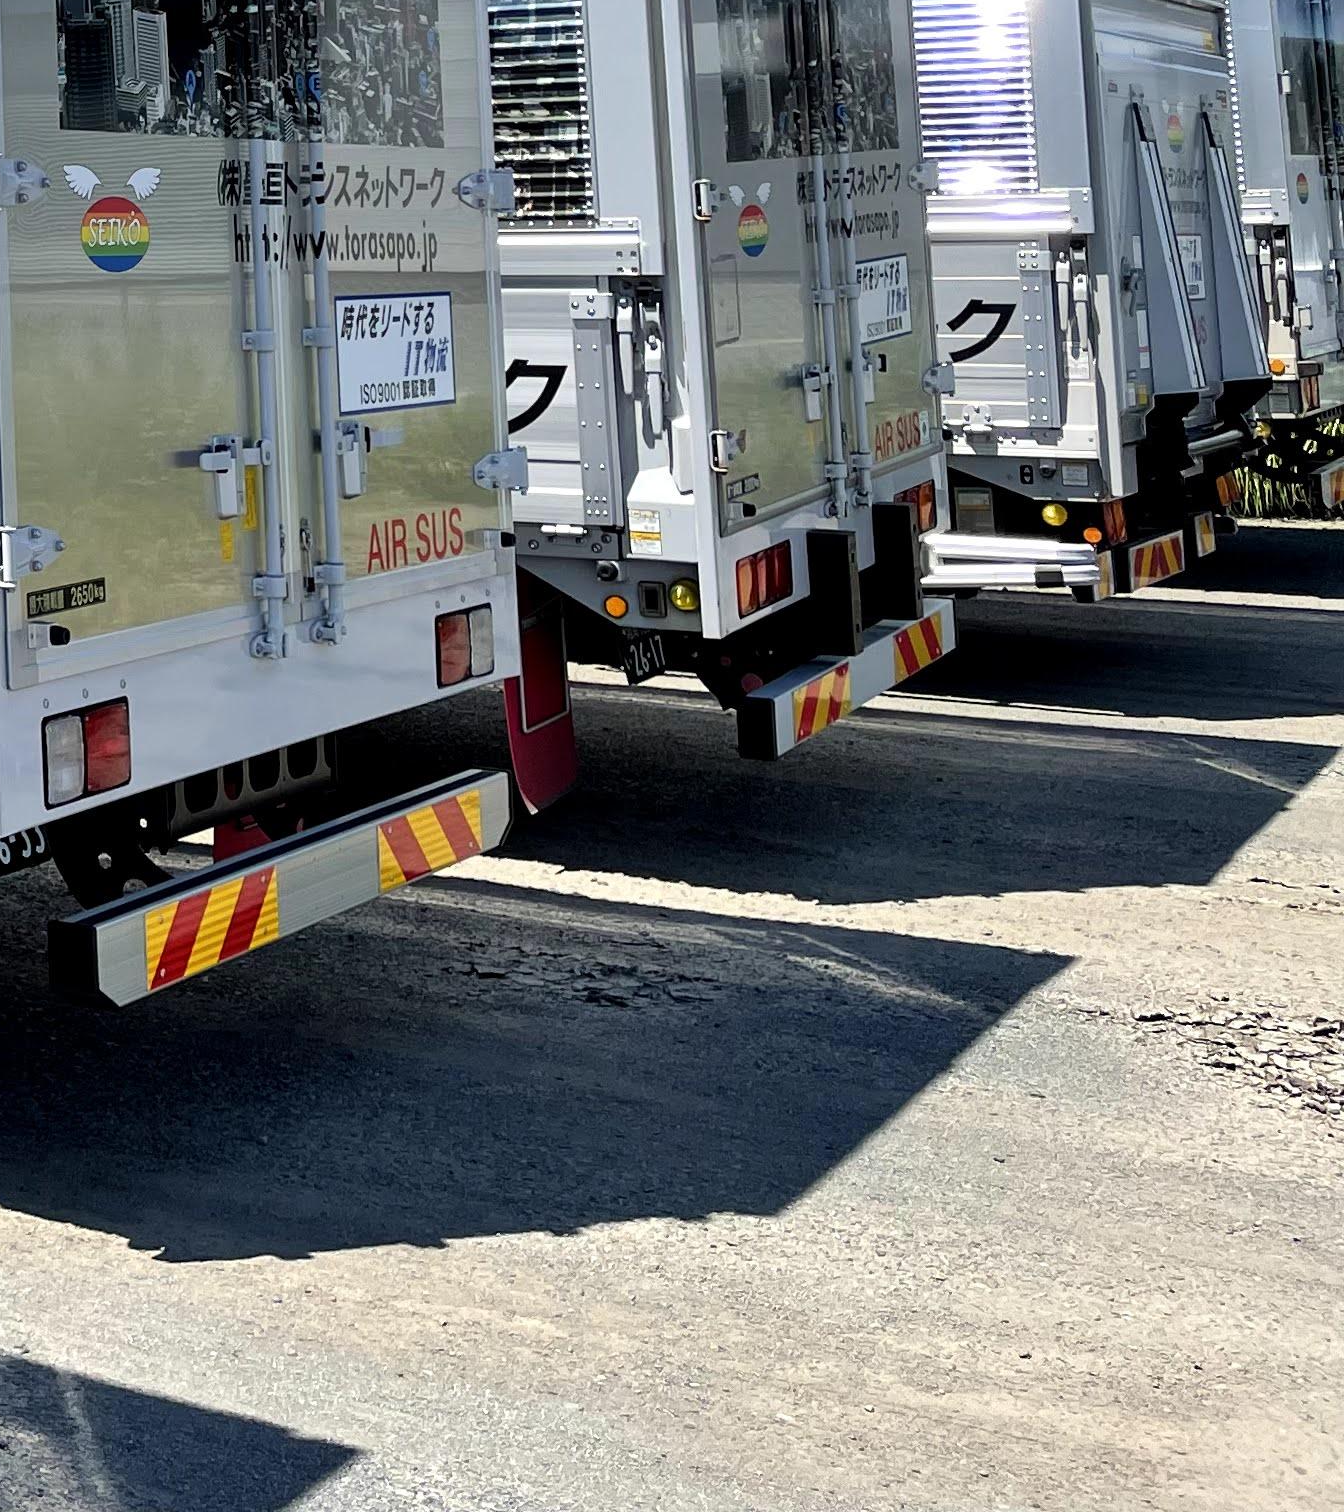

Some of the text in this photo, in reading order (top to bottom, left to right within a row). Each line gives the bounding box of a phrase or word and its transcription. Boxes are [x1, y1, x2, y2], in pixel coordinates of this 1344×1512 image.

[340, 302, 434, 340] 時代をリードする
[946, 298, 1017, 363] ク
[875, 410, 921, 462] AIR SUS
[368, 507, 464, 573] AIR SUS
